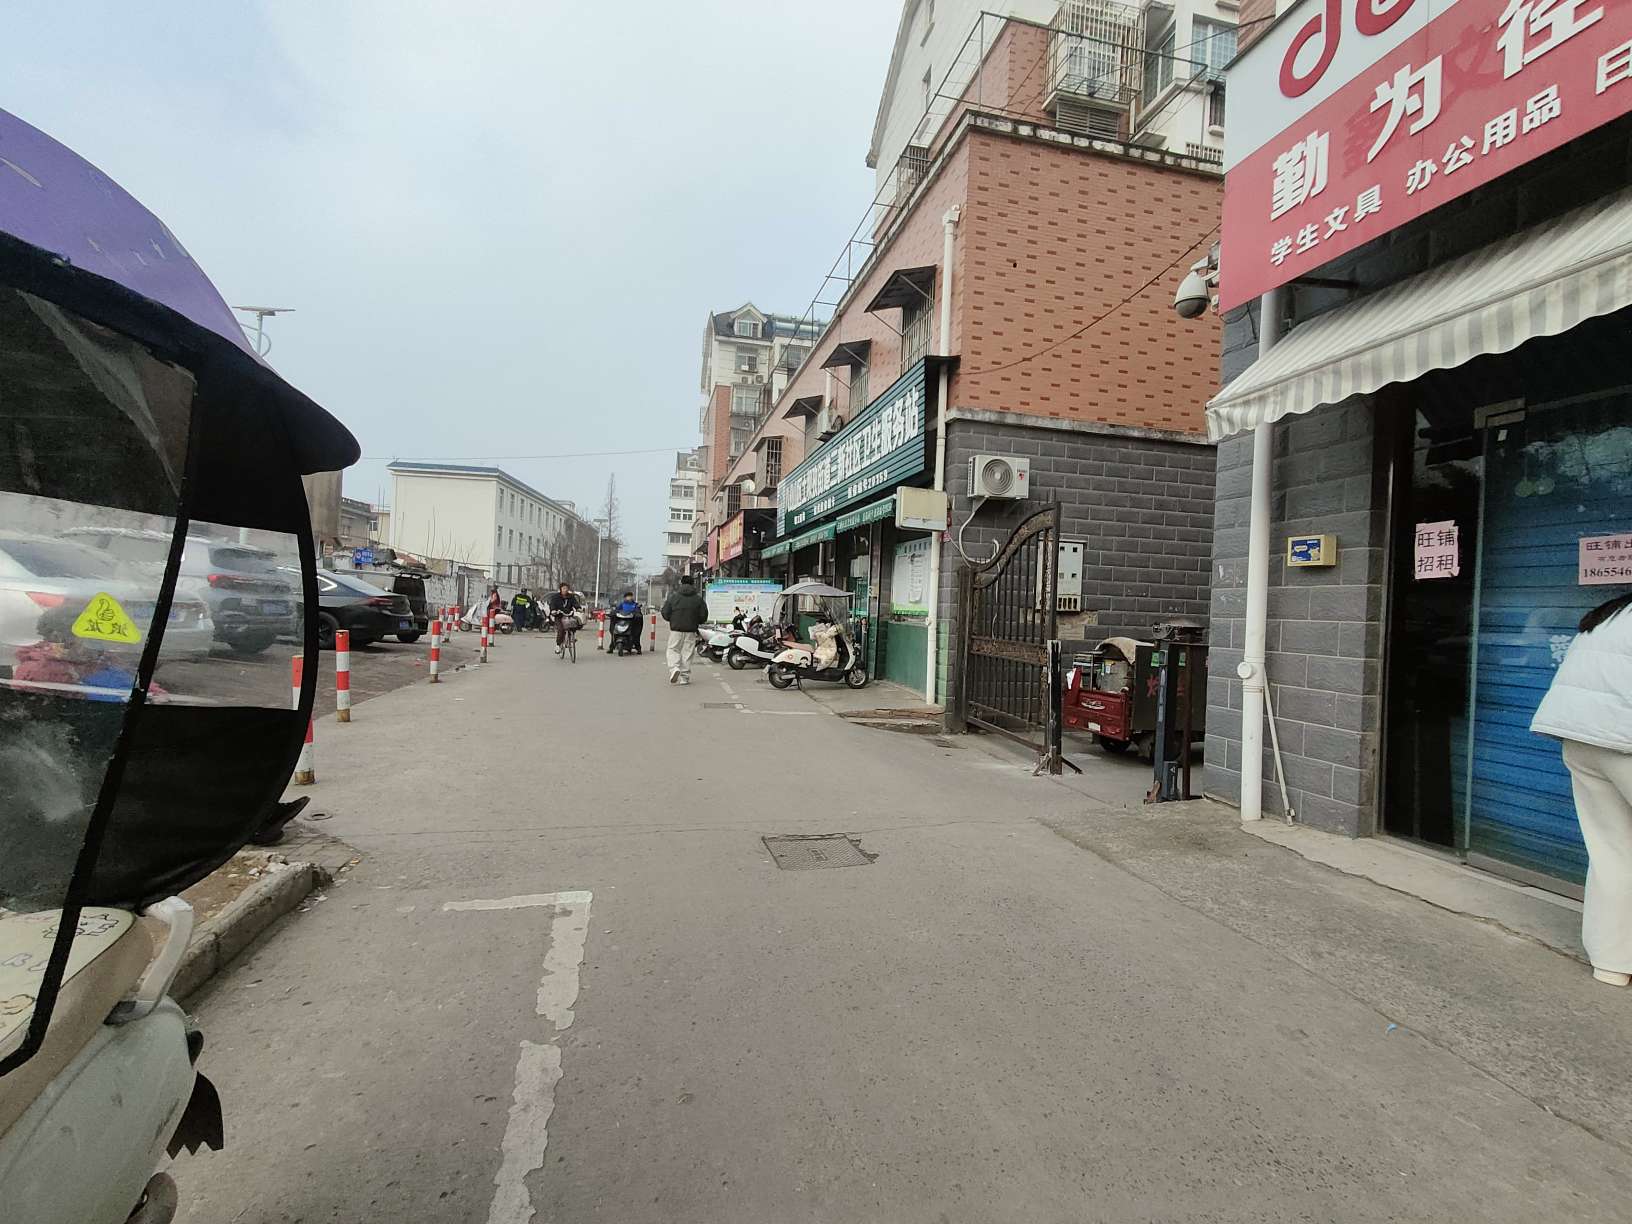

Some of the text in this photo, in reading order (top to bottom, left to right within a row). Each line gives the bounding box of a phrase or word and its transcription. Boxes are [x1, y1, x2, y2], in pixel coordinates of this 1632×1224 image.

[1270, 184, 1383, 266] 学生文具
[1406, 84, 1562, 195] 办公用品
[1417, 528, 1455, 548] 旺铺
[1417, 554, 1454, 573] 招租
